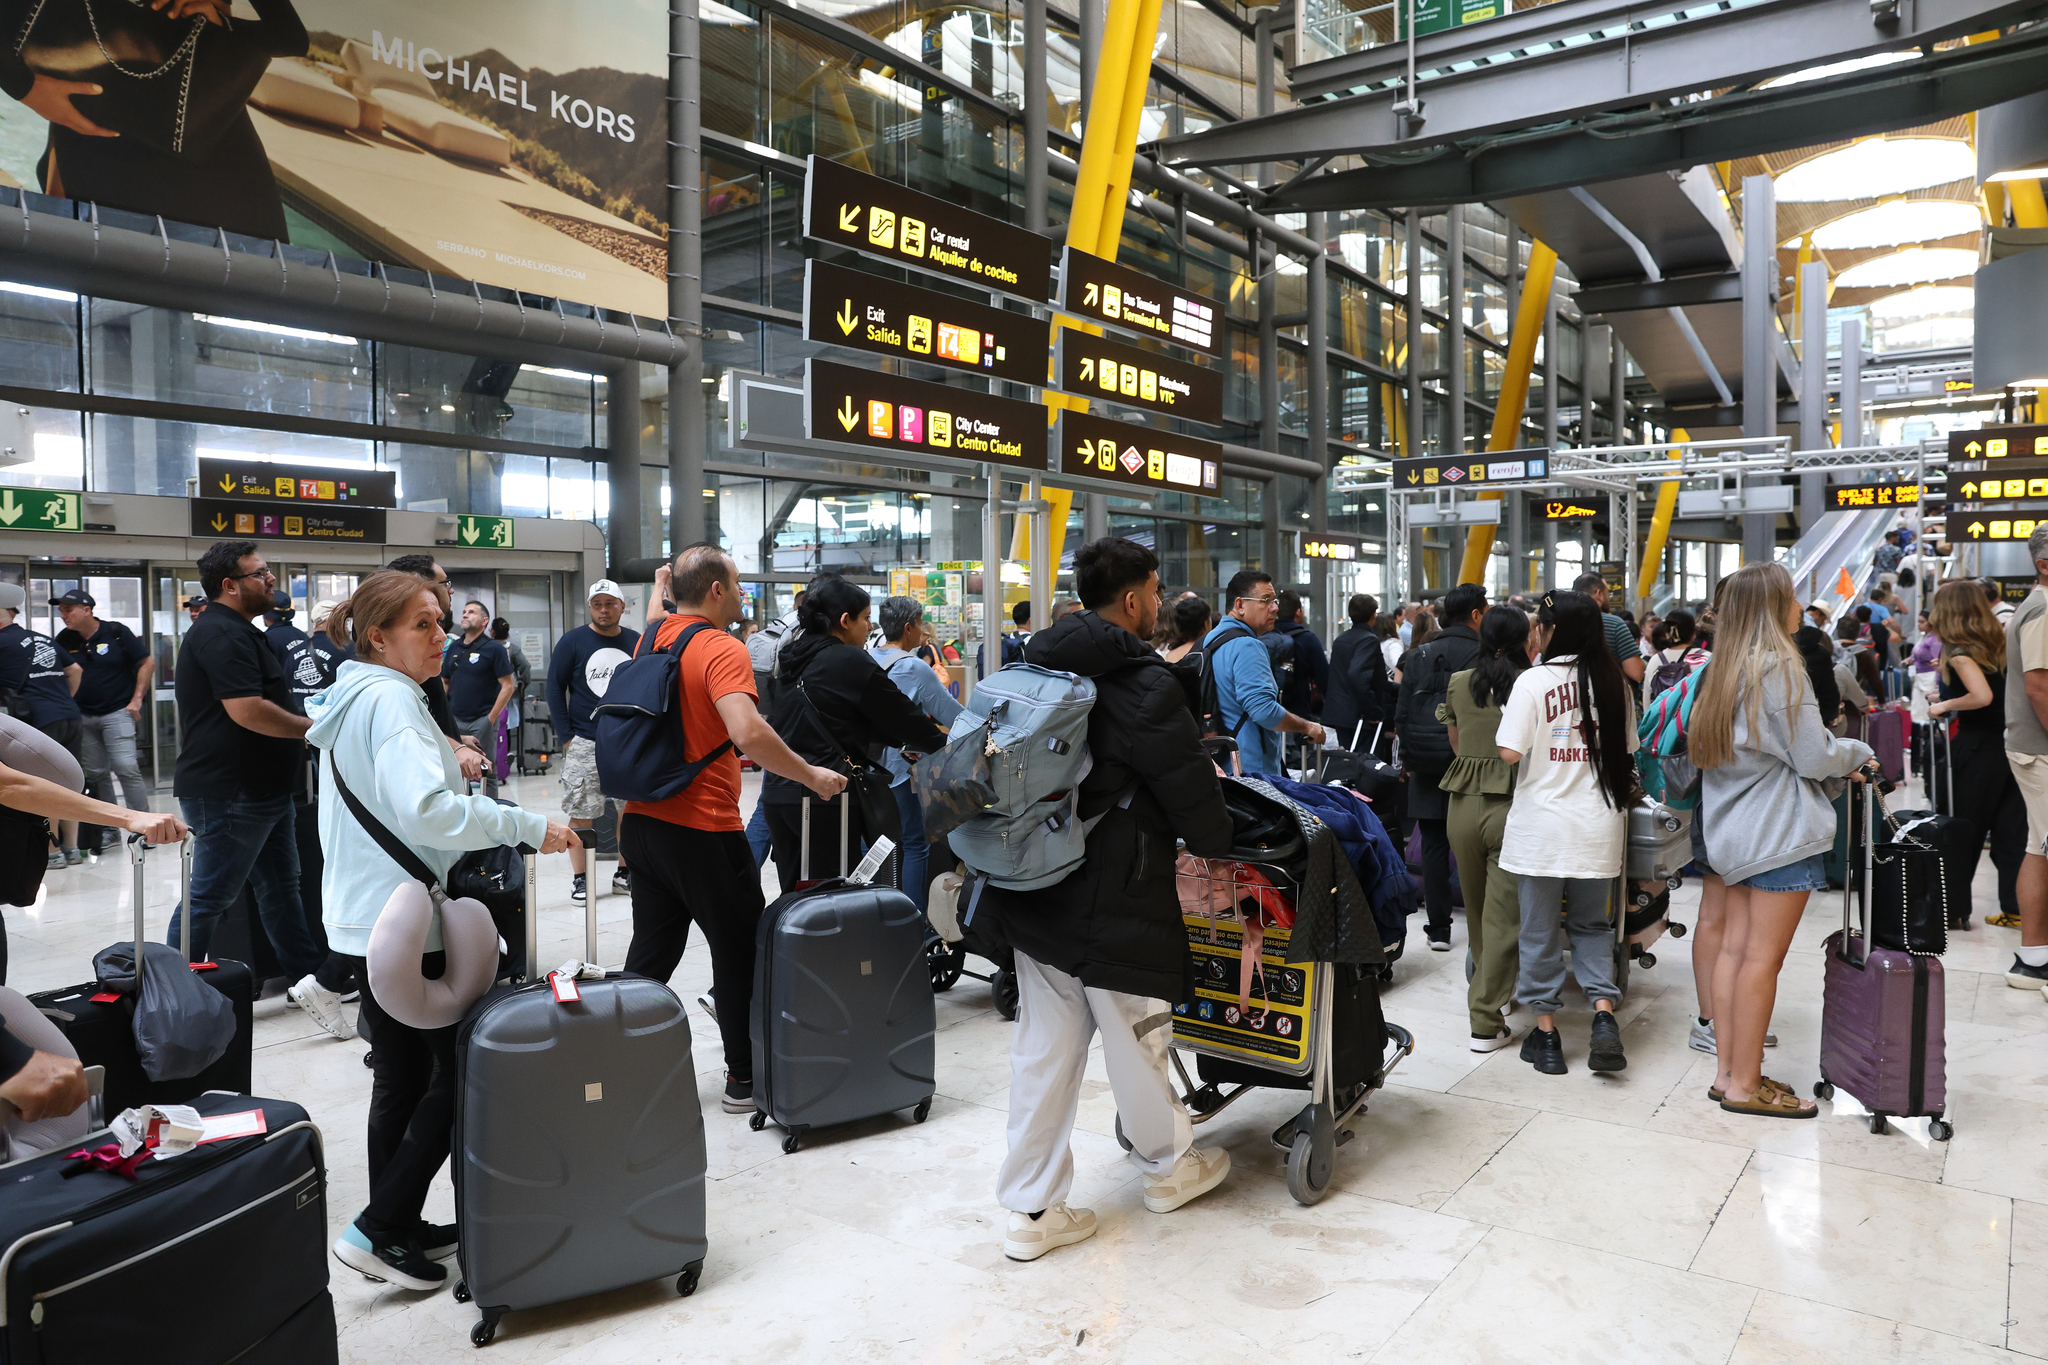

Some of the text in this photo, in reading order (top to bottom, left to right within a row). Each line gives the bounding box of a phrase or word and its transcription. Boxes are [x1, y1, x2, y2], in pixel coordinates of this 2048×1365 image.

[372, 29, 636, 143] MICHAEL KORS
[930, 227, 970, 251] Car rental
[437, 240, 586, 281] SERRANO MICHAELKORS.COM
[929, 245, 1018, 285] Alquiler de coches
[1123, 292, 1161, 315] Bus Terminal
[866, 305, 886, 323] Exit
[1123, 307, 1170, 334] Terminal Bus
[913, 318, 927, 328] TAXI
[866, 324, 901, 346] Salida
[938, 331, 959, 357] T4
[1159, 389, 1175, 405] VTC
[872, 402, 885, 424] P
[903, 408, 915, 429] P
[955, 416, 1000, 437] City Center
[956, 433, 1022, 457] Centro Ciudad
[1492, 464, 1520, 476] renfe
[242, 475, 257, 485] Exit
[243, 485, 271, 495] Salida
[300, 484, 318, 497] T4
[1837, 488, 1874, 498] SUELTE
[1877, 487, 1892, 496] LA
[1837, 498, 1845, 506] Y
[1848, 496, 1874, 506] PARE
[1877, 495, 1892, 504] EL
[239, 515, 248, 526] P
[264, 515, 273, 527] P
[307, 518, 345, 528] City Center
[307, 527, 364, 538] Centro Ciudad
[2006, 590, 2024, 598] VTC
[588, 667, 609, 681] Jack
[1549, 747, 1590, 763] BASKE
[1188, 934, 1205, 944] Trolley
